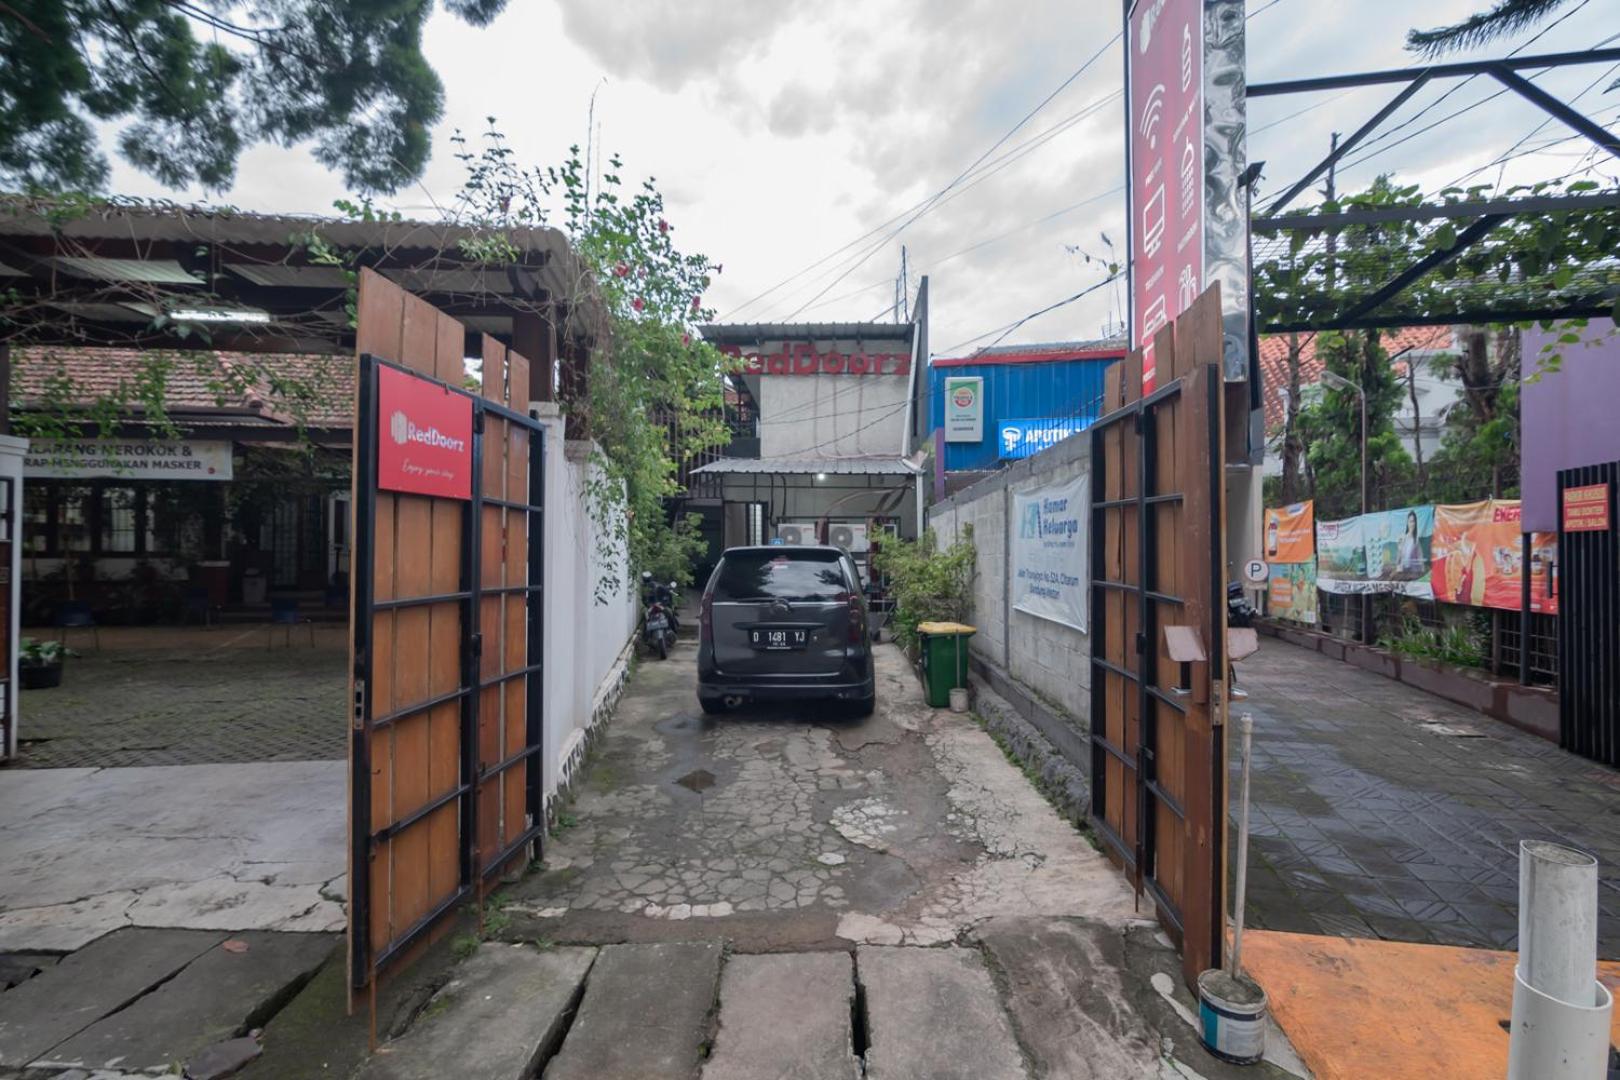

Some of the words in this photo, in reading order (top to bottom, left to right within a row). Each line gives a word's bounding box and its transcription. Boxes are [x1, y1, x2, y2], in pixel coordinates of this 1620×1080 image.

[407, 421, 465, 452] RedDoorz
[182, 445, 193, 457] &
[152, 460, 202, 470] MASKER
[1251, 562, 1263, 578] P
